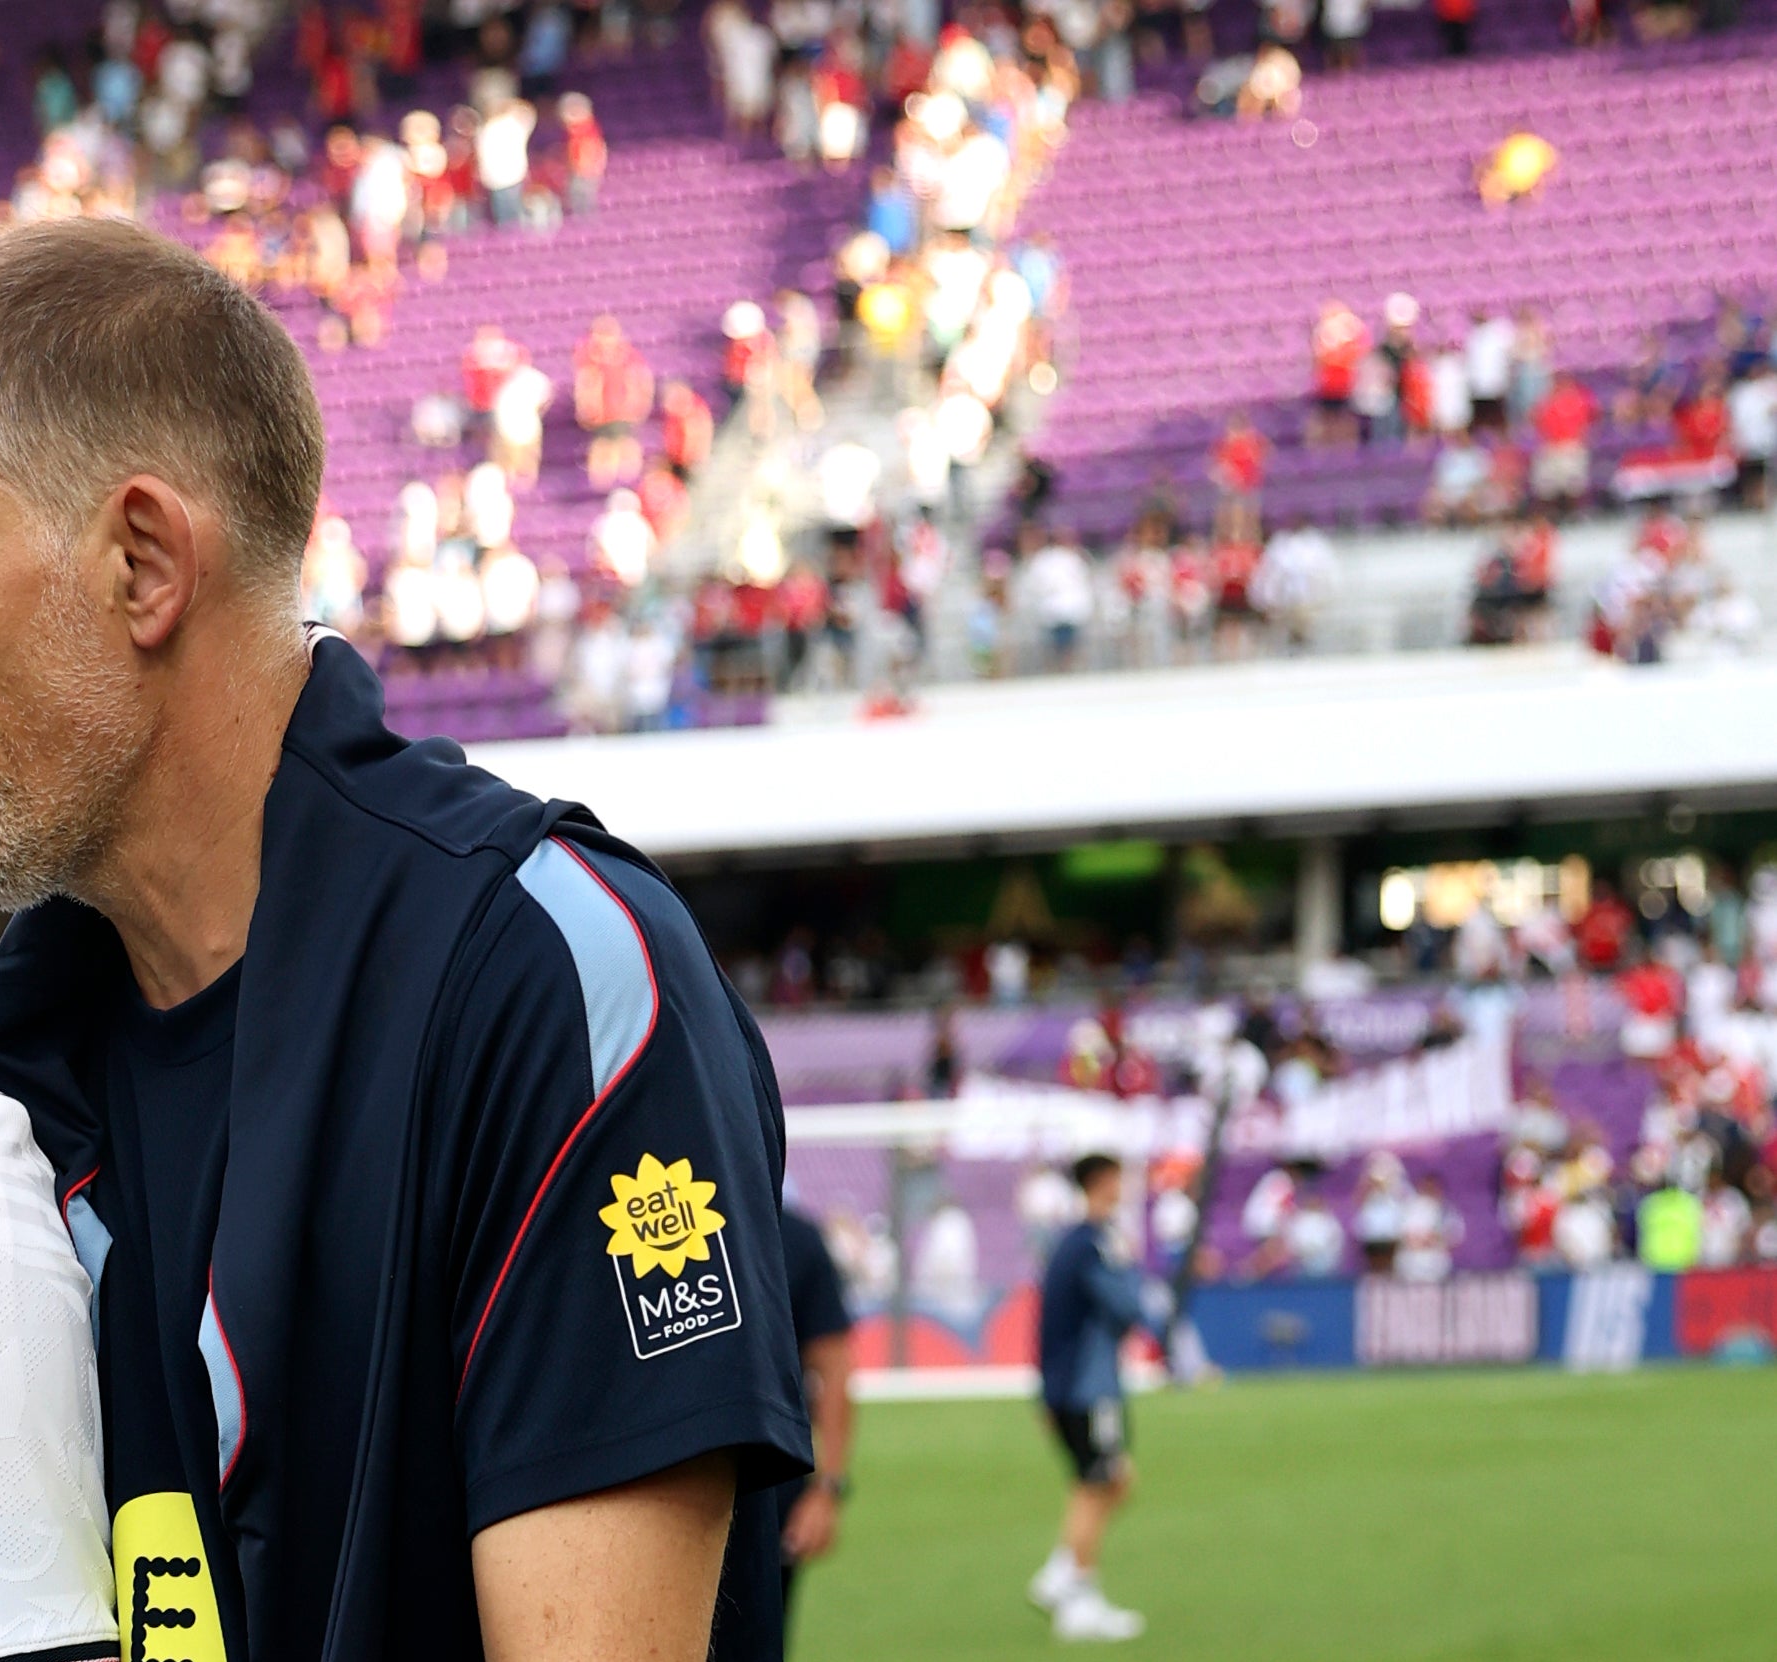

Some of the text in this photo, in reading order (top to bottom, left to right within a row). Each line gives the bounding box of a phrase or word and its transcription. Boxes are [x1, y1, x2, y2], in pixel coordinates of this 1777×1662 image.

[626, 1180, 679, 1219] eat
[631, 1199, 697, 1243] well
[637, 1274, 724, 1328] M&S
[663, 1314, 711, 1339] FOOD
